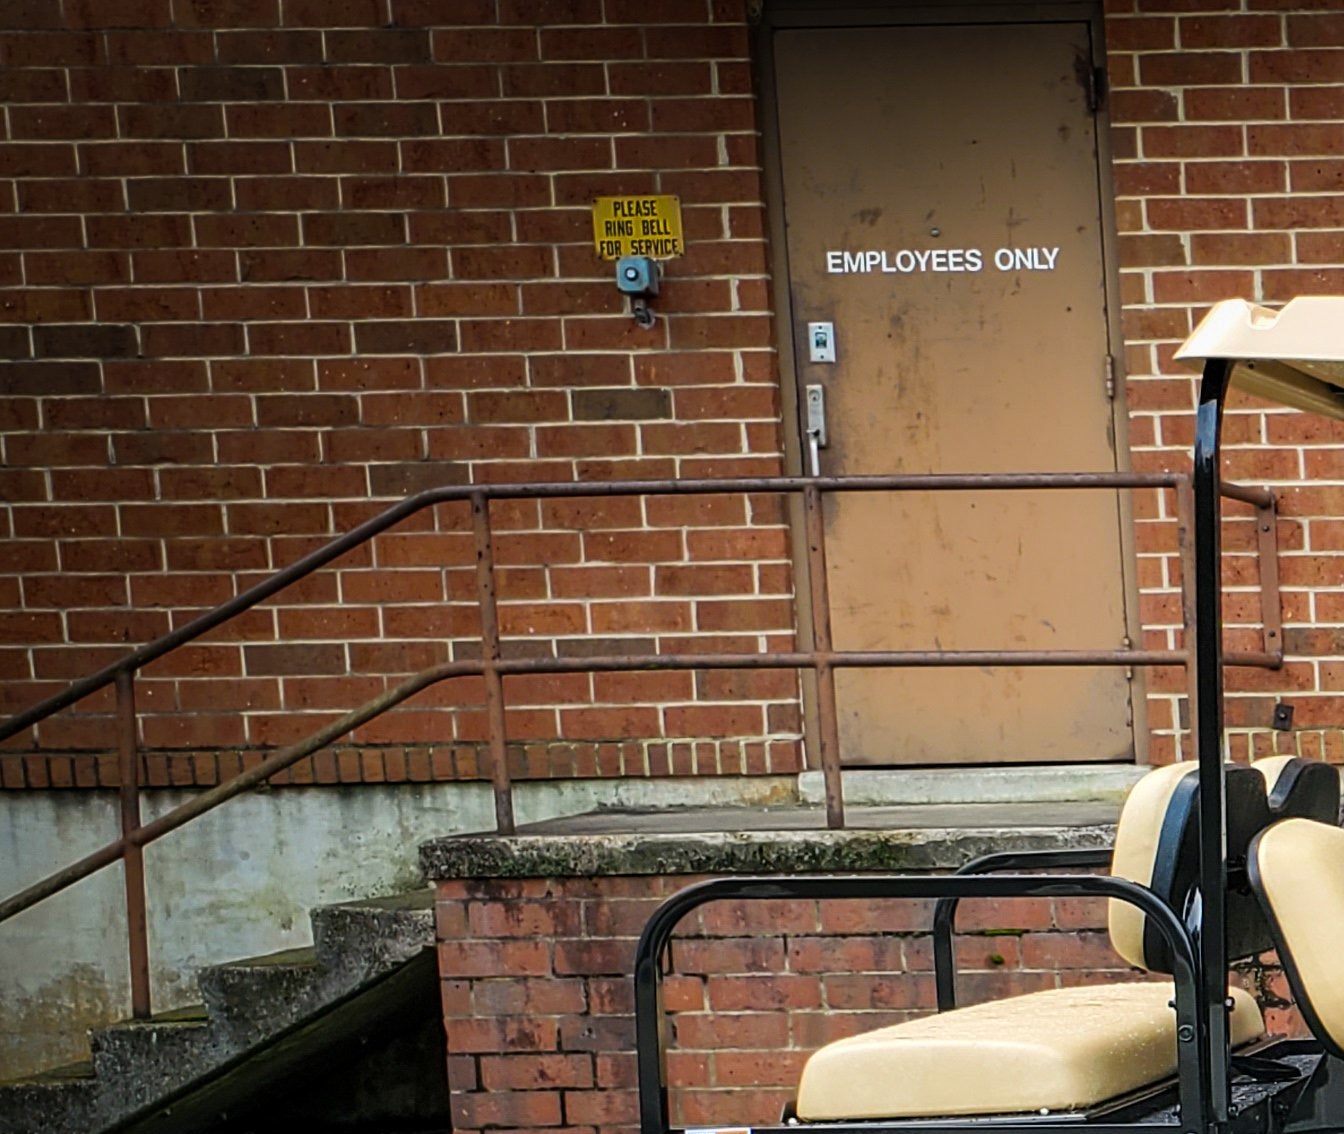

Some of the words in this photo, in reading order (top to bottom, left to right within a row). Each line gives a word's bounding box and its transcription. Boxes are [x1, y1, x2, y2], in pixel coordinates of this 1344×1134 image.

[613, 200, 658, 218] PLEASE
[605, 220, 633, 237] RING
[642, 218, 671, 235] BELL
[600, 240, 622, 256] FOR
[631, 238, 679, 256] SERVICE
[826, 249, 983, 274] EMPLOYEES
[994, 247, 1060, 272] ONLY
